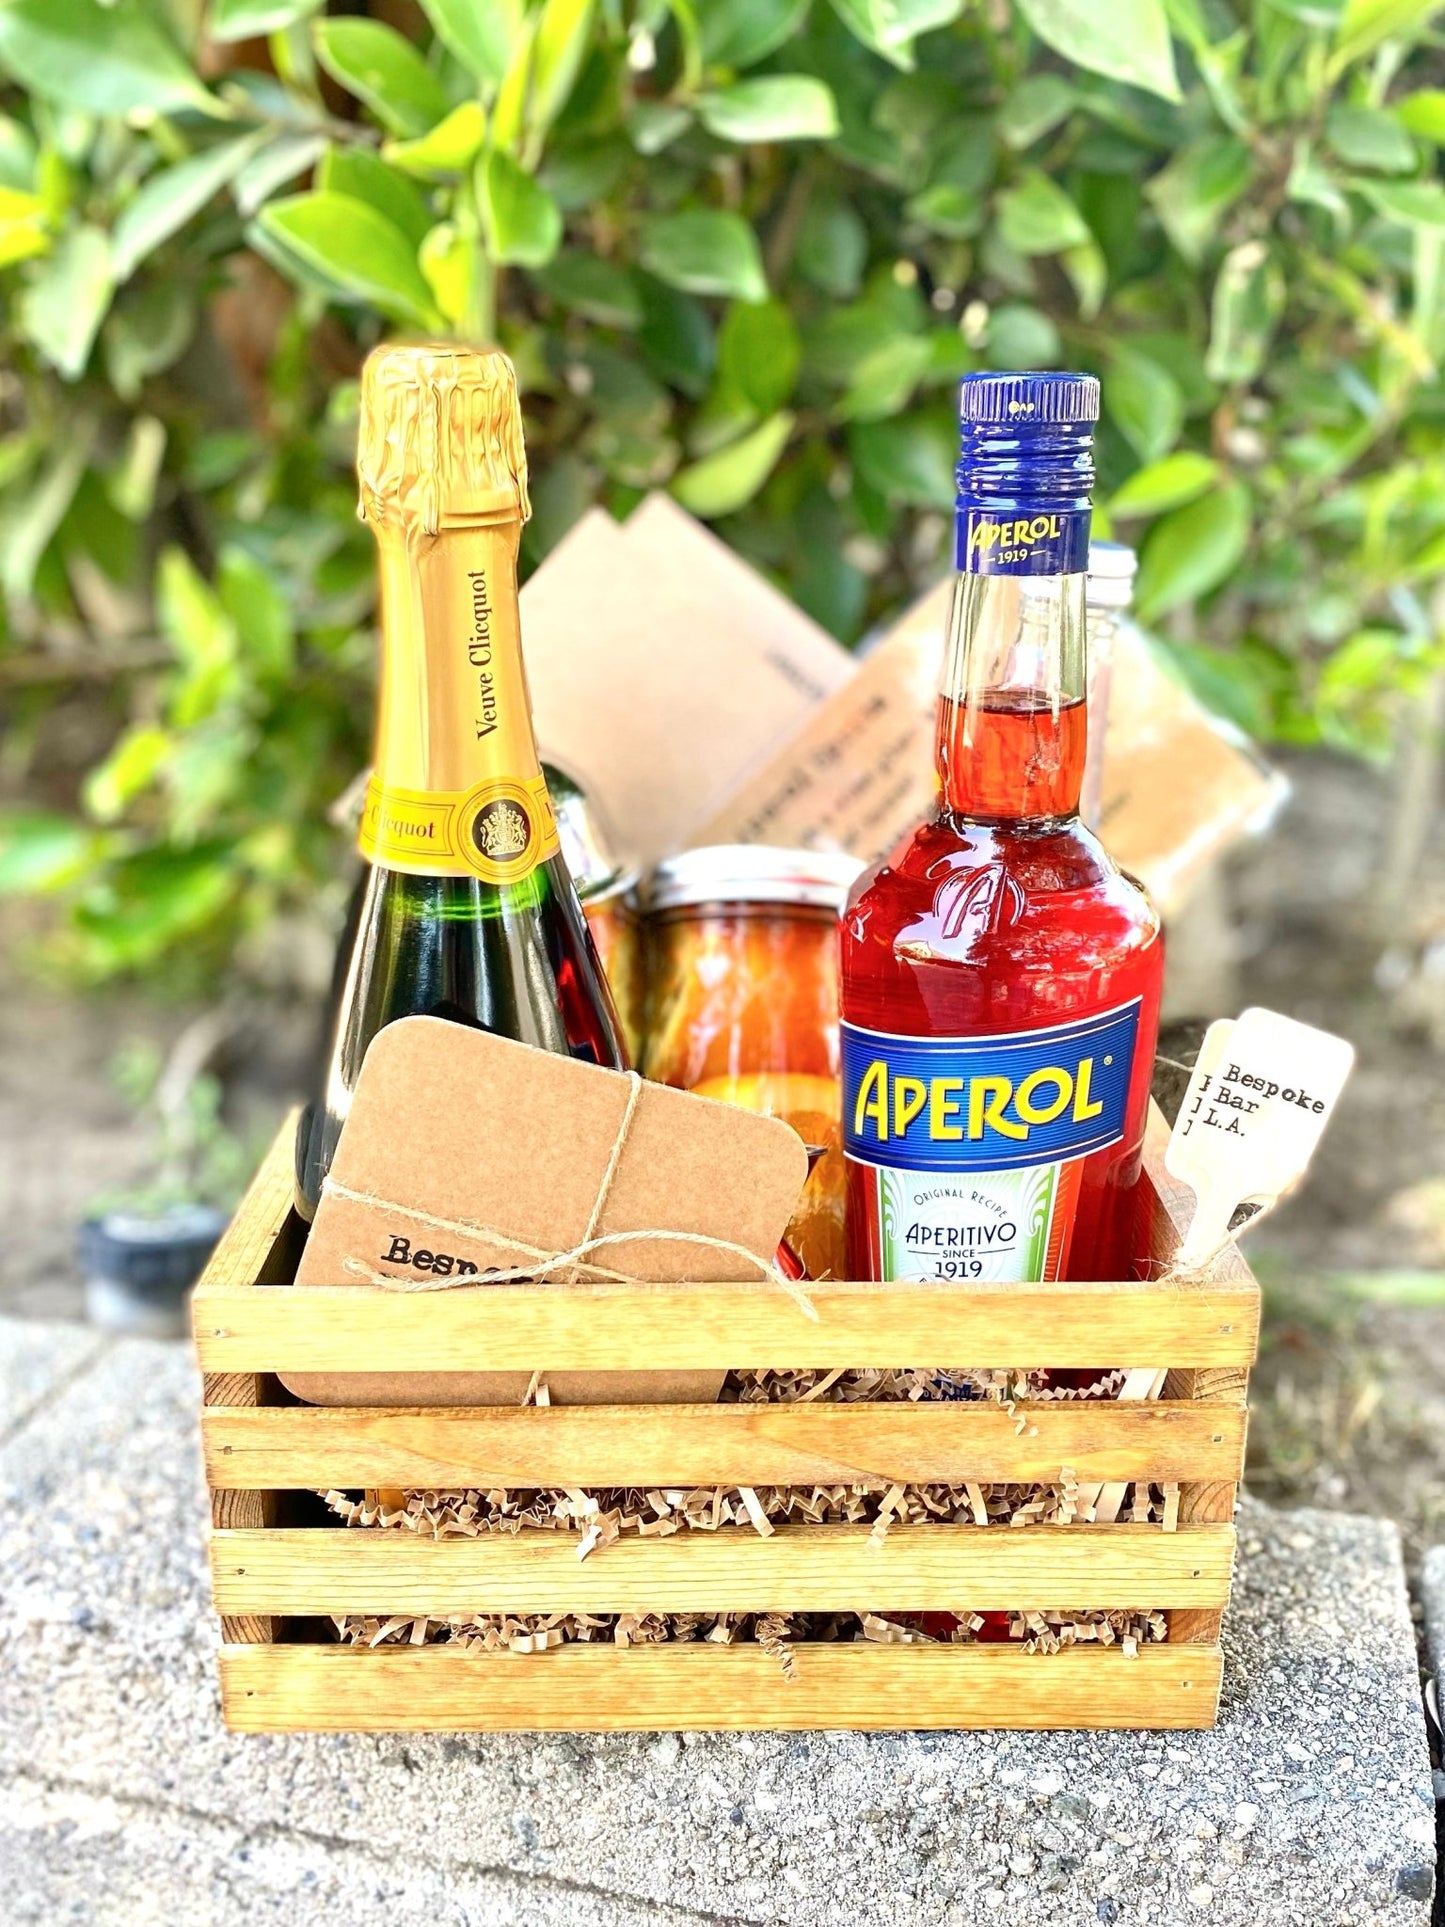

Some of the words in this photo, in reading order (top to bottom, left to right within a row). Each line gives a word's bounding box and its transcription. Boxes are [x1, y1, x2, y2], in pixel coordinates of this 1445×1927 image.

[971, 514, 1061, 553] APEROL
[997, 548, 1028, 565] 1919
[468, 569, 493, 667] Clicquot
[475, 672, 498, 741] Veuve
[854, 1057, 1104, 1142] APEROL
[1213, 1085, 1260, 1114] Bar
[1222, 1063, 1325, 1115] Bespoke
[1203, 1108, 1246, 1137] L.A.
[913, 1187, 964, 1206] ORIGINAL
[971, 1190, 1008, 1219] RECIPE
[905, 1222, 1017, 1246] APERITIVO
[942, 1249, 976, 1259] SINCE
[935, 1260, 983, 1279] 1919
